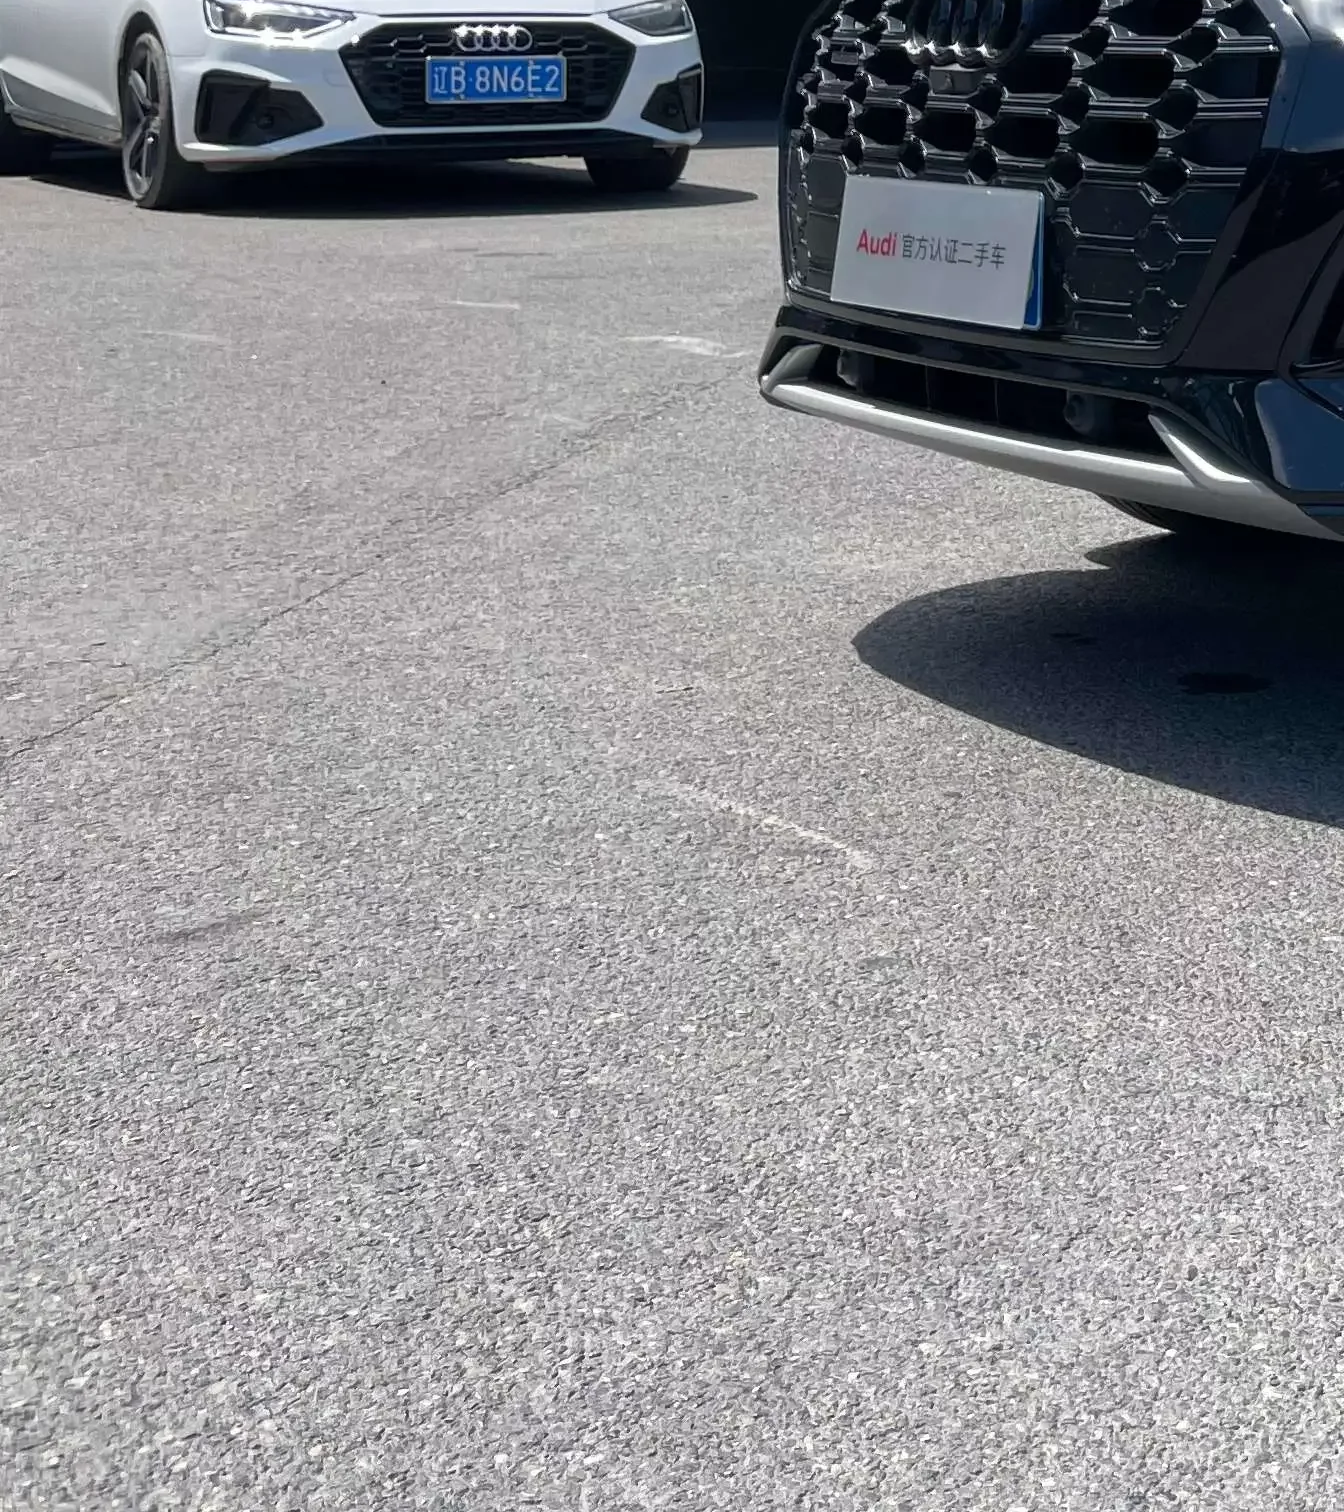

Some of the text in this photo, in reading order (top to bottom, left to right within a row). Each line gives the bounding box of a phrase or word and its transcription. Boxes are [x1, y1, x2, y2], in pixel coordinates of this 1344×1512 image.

[857, 228, 1006, 270] Audi 官方认证二手车
